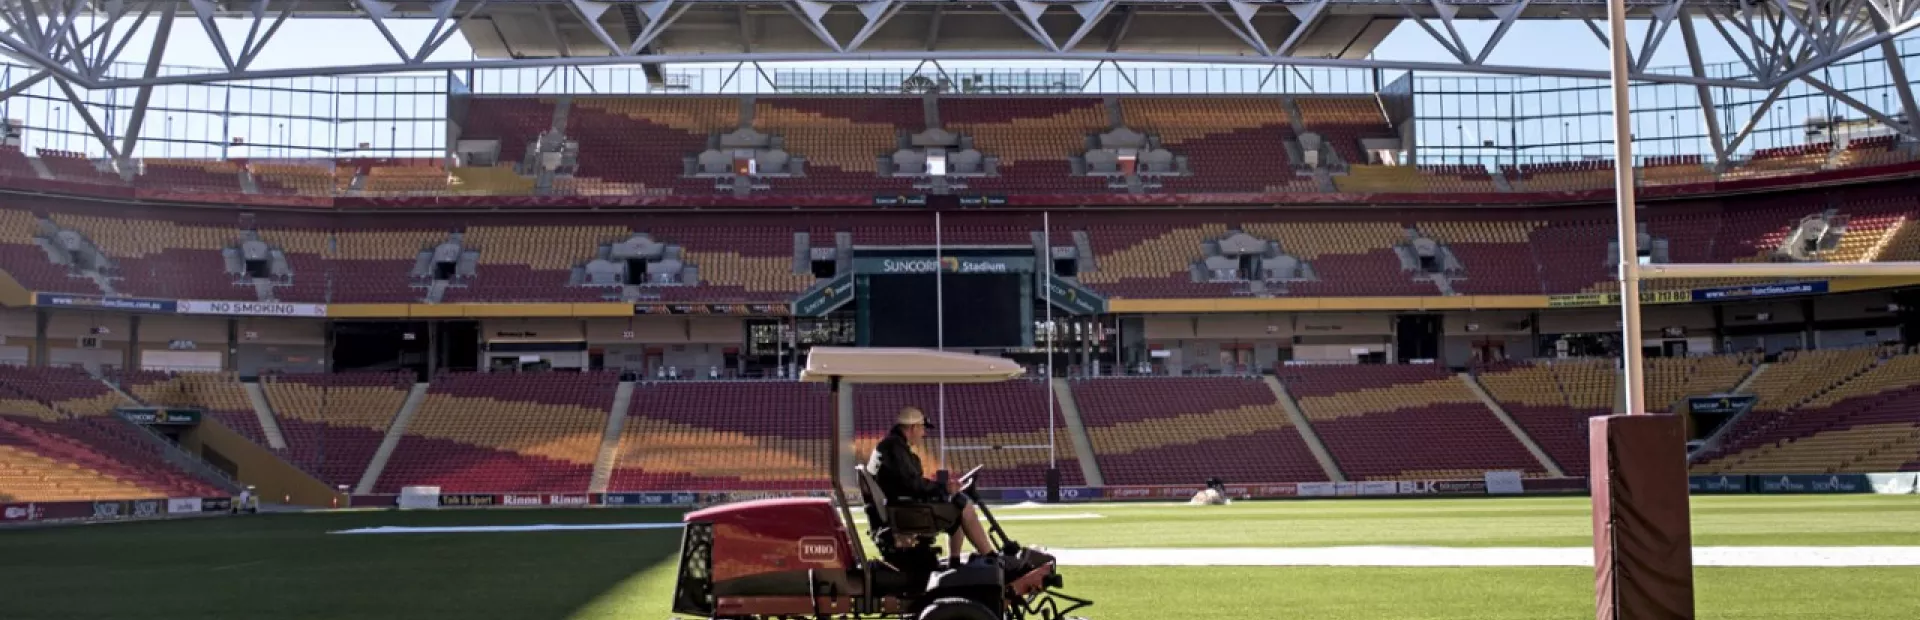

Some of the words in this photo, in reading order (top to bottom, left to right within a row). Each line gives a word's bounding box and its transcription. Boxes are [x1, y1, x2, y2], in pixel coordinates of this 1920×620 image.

[963, 261, 1005, 271] Stadium
[210, 303, 230, 312] NO
[233, 303, 295, 314] SMOKING
[1400, 481, 1438, 493] BLK
[1026, 489, 1078, 498] VOVO
[503, 494, 541, 505] Rinnai
[551, 494, 589, 505] Rinnai
[804, 543, 834, 555] TORO
